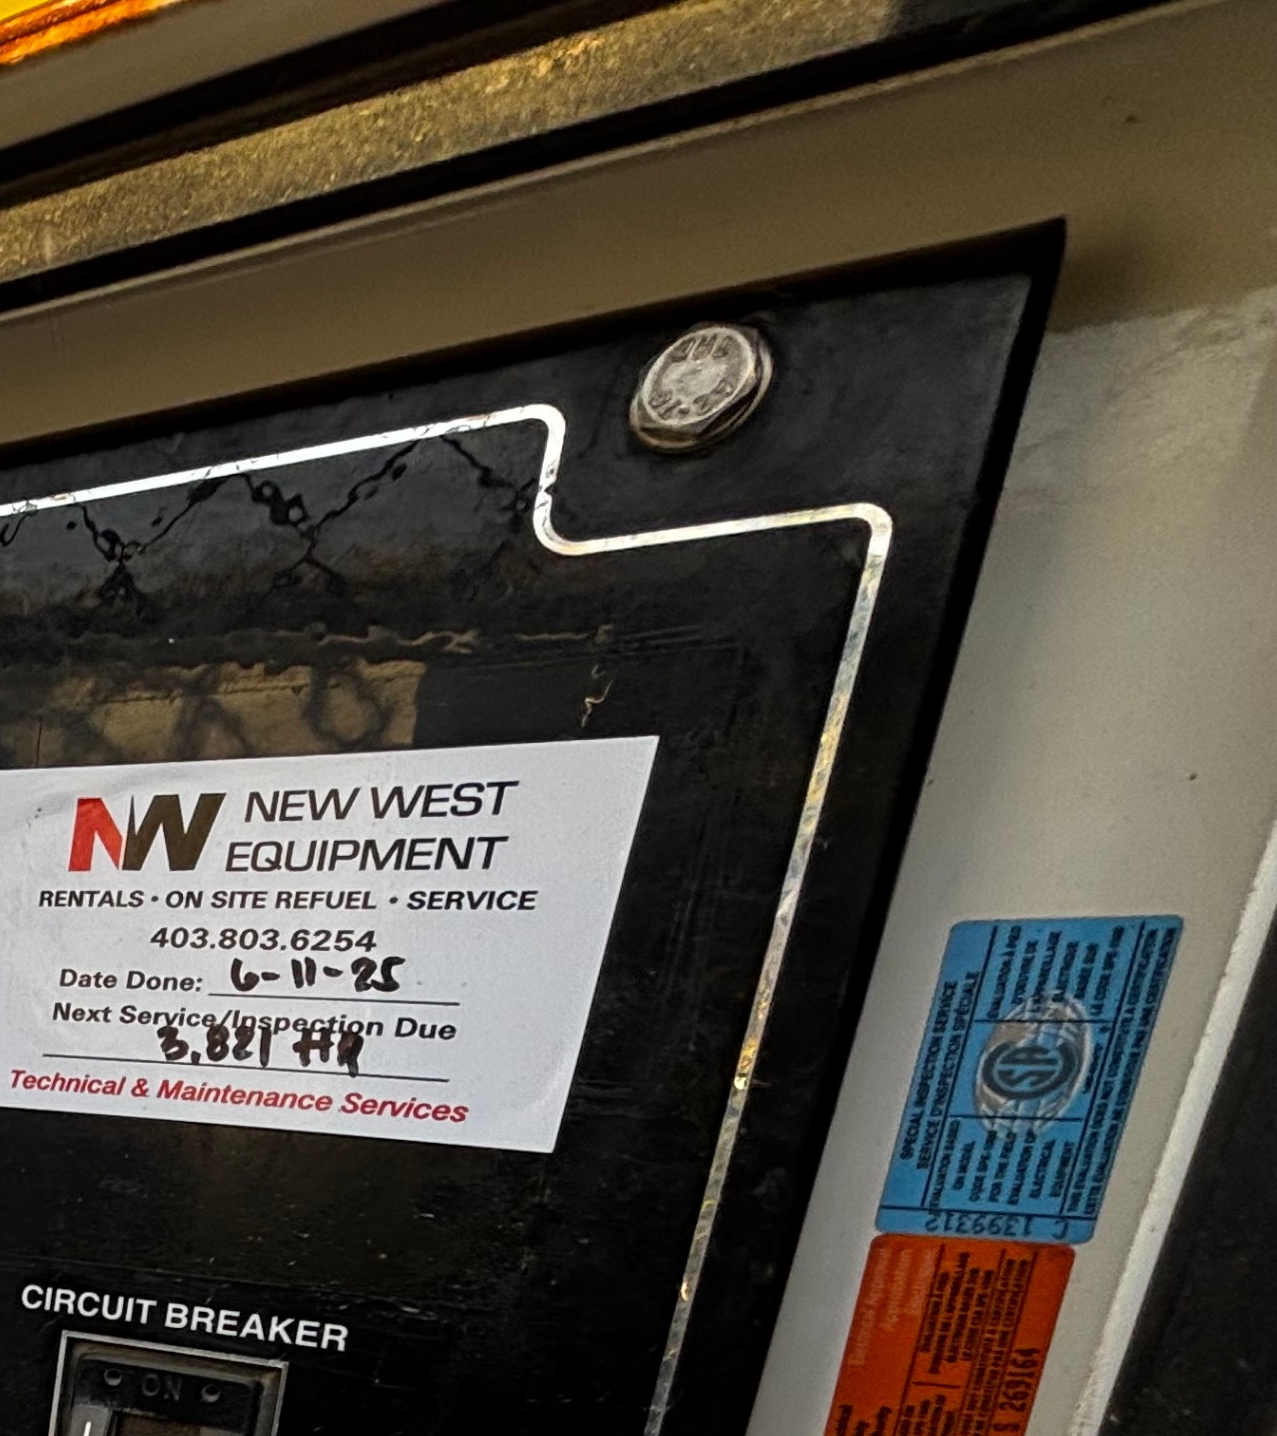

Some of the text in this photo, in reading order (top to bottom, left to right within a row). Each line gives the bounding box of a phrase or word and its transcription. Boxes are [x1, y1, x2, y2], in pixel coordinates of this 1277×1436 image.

[245, 780, 520, 822] NEW WEST
[68, 793, 227, 871] NW
[225, 836, 510, 872] EQUIPMENT
[39, 890, 538, 910] RENTALS ON SITE REFUEL SERVICE
[150, 927, 377, 952] 403.803.6254
[59, 969, 203, 992] Date Done:
[52, 1002, 457, 1040] Next Service/Inspection Due
[899, 981, 957, 1159] SPECIAL INSPECTION SERVICE
[916, 971, 979, 1168] SERVICE D'INSPECTION SPÉCIALE
[11, 1070, 469, 1122] Technical & Maintenance Services
[21, 1284, 349, 1352] CIRCUIT BREAKER
[142, 1373, 183, 1402] ON
